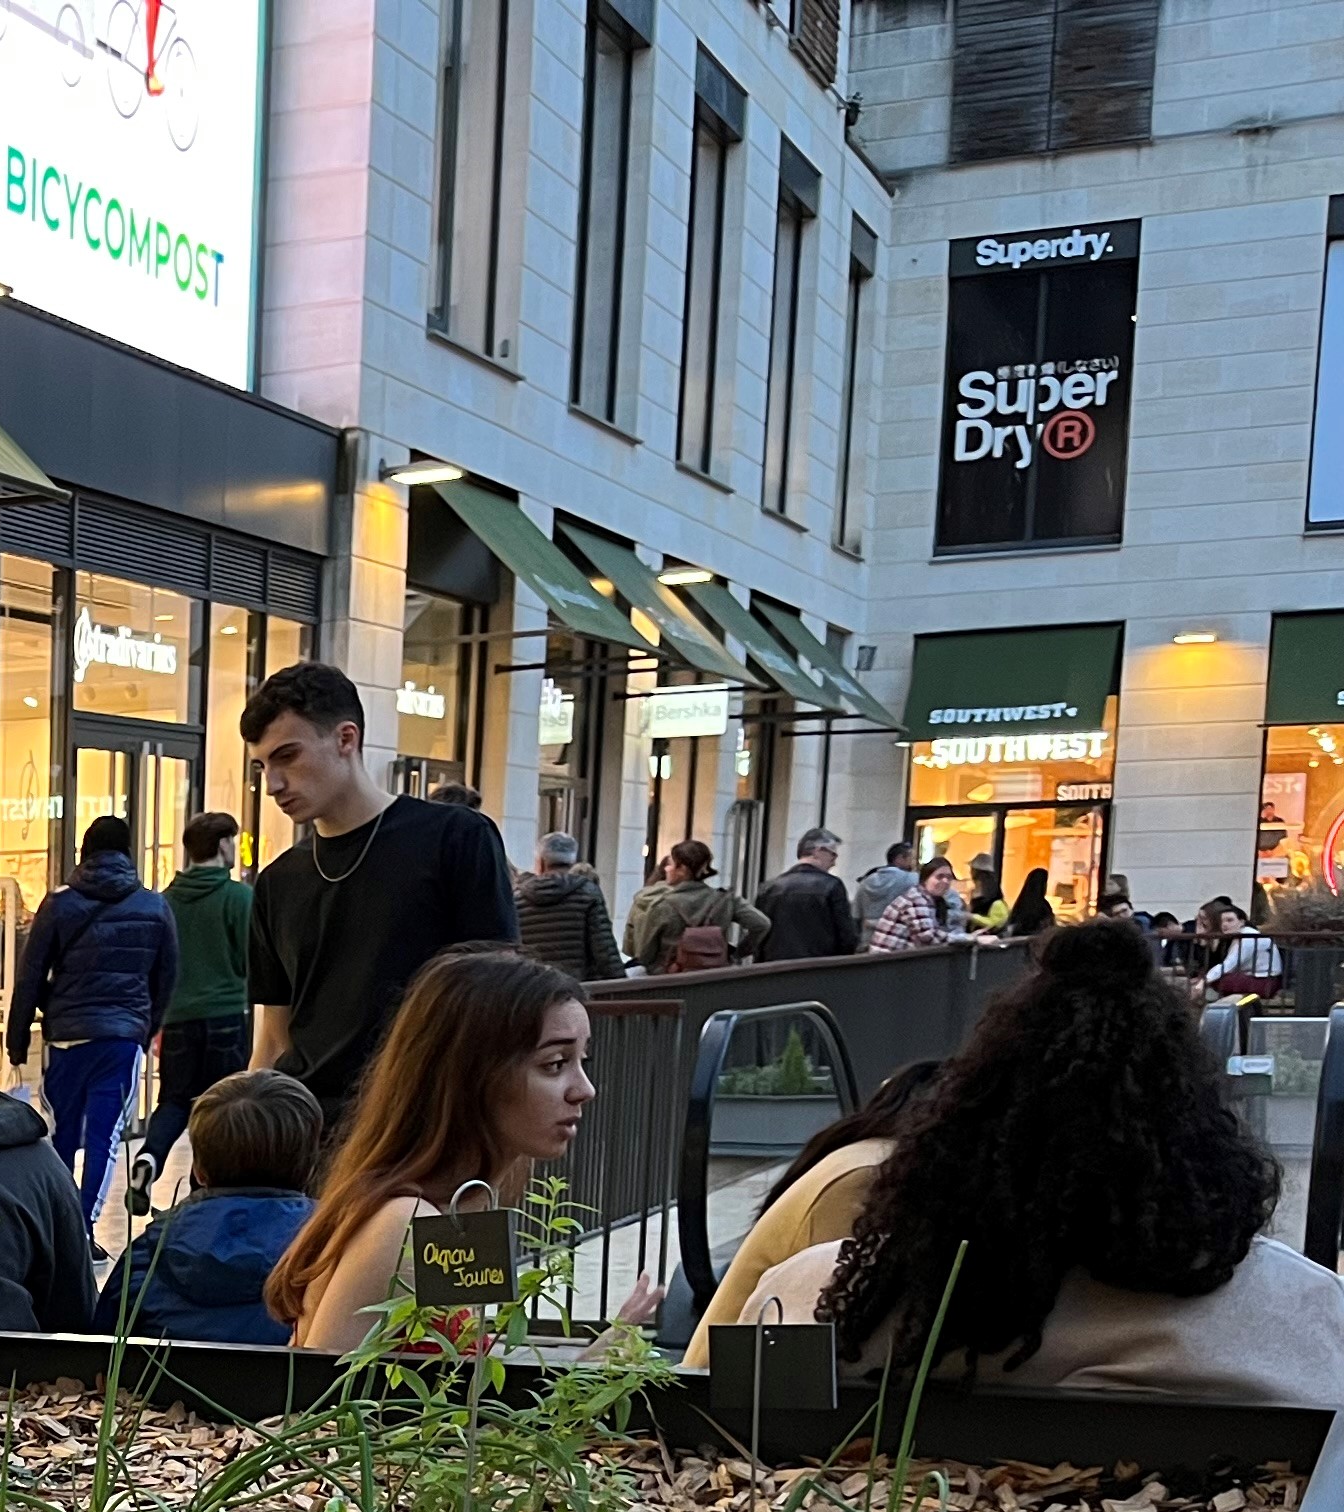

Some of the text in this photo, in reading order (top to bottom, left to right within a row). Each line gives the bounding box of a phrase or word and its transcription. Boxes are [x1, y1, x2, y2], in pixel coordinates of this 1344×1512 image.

[7, 145, 224, 307] BICYCOMPOST
[956, 370, 1119, 425] Super
[655, 701, 722, 722] Bershka
[928, 703, 1067, 724] SOUTHWEST
[931, 732, 1108, 768] SOUTHWEST
[453, 1266, 505, 1288] Jaunes
